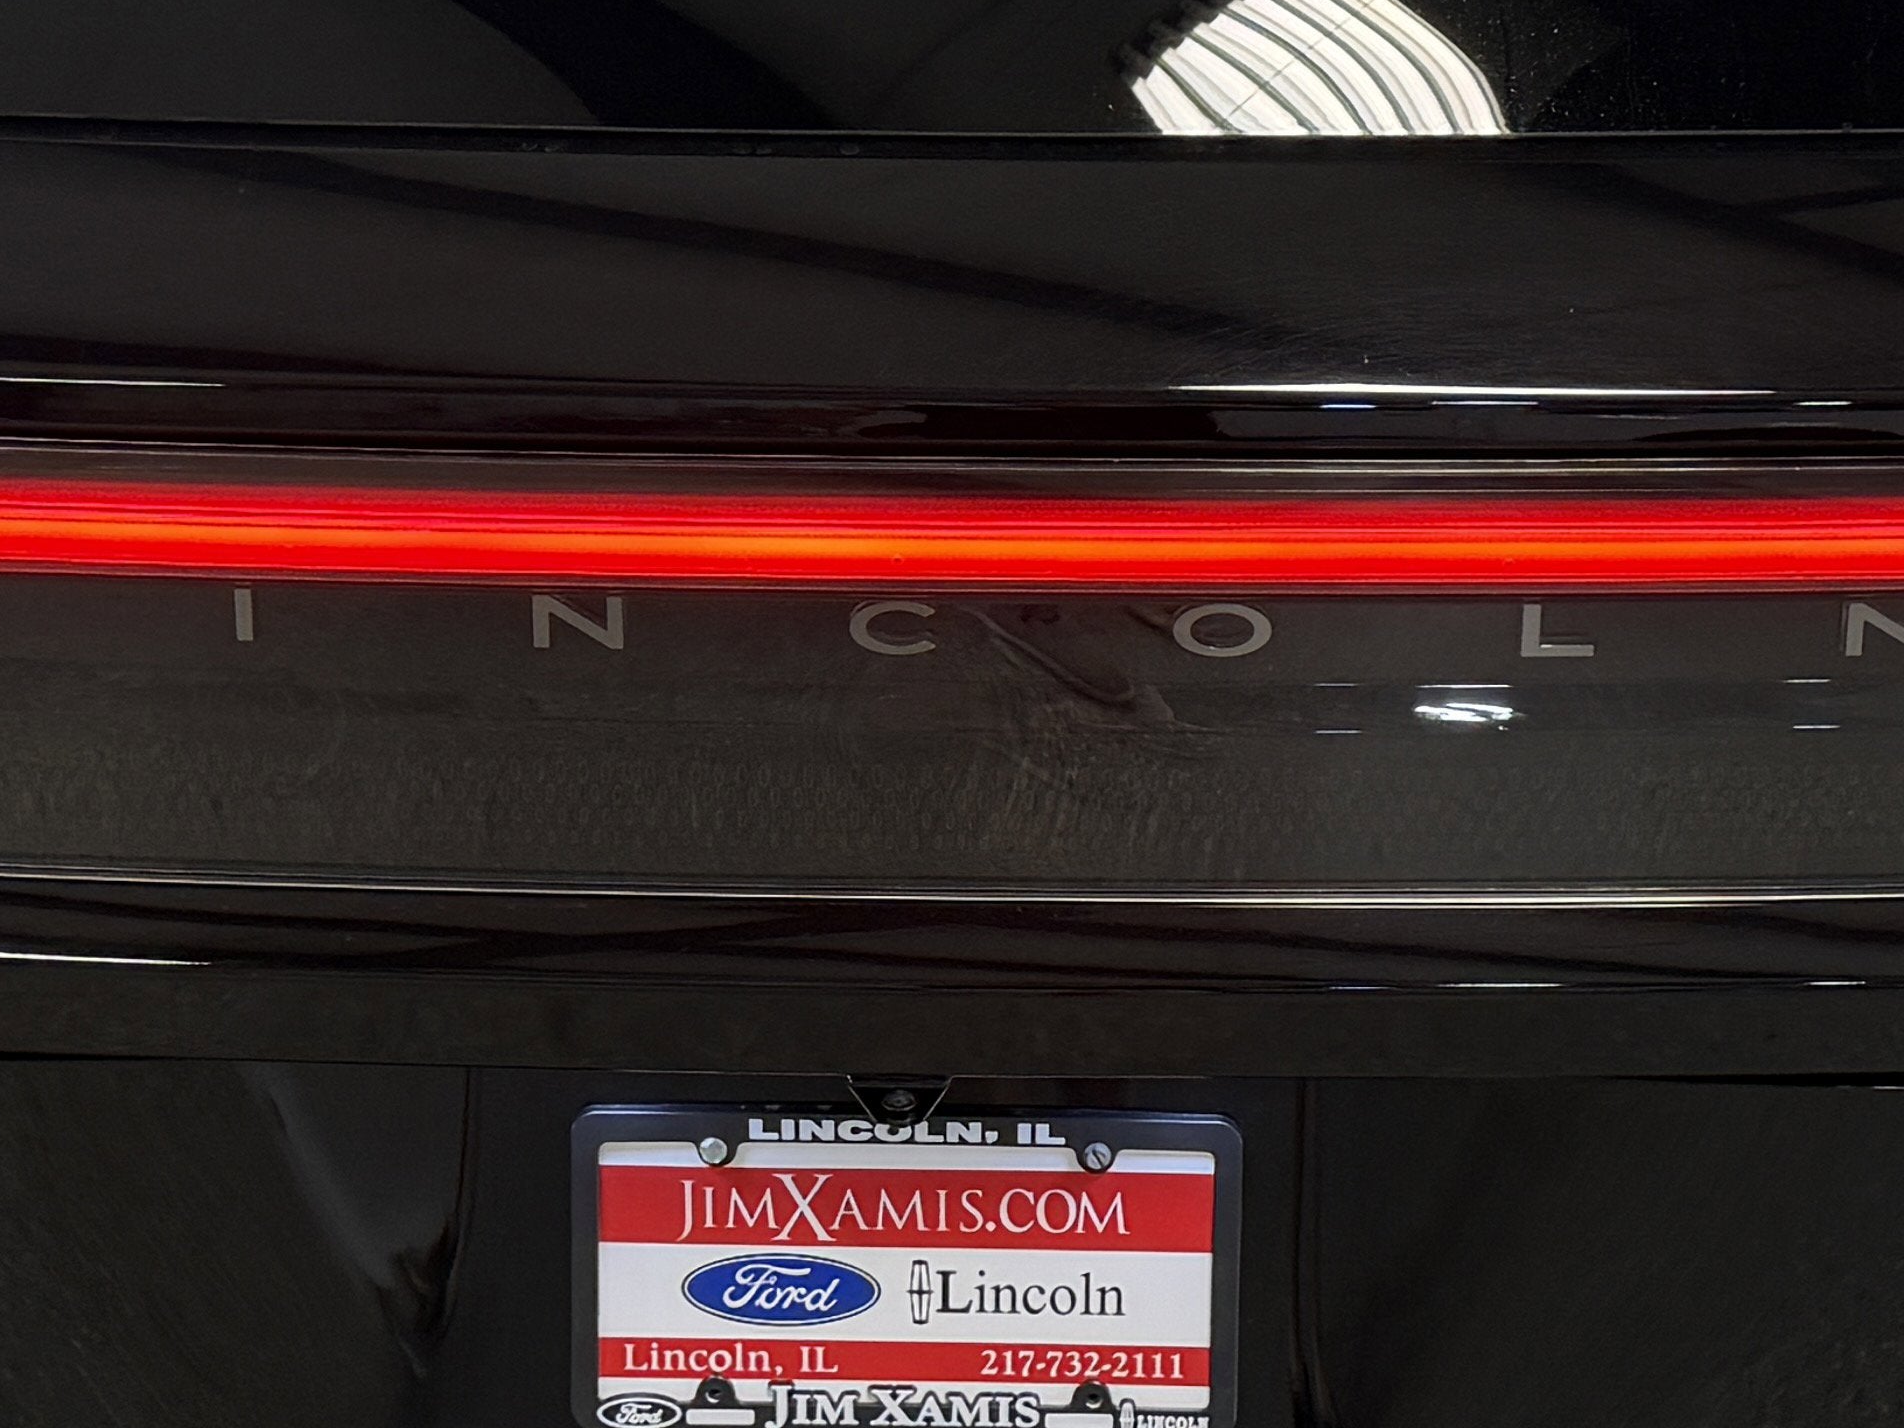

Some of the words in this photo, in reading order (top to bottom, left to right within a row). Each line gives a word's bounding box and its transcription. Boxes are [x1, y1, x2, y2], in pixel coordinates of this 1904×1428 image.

[748, 1118, 999, 1144] LINCOLN,
[1016, 1122, 1067, 1146] IL
[676, 1173, 1132, 1243] JIMXAMIS.COM
[722, 1263, 840, 1312] Ford
[934, 1269, 1127, 1317] Lincoln
[623, 1341, 784, 1376] Lincoln,
[799, 1345, 840, 1374] IL
[980, 1349, 1186, 1380] 217-732-2111
[616, 1403, 665, 1427] Ford
